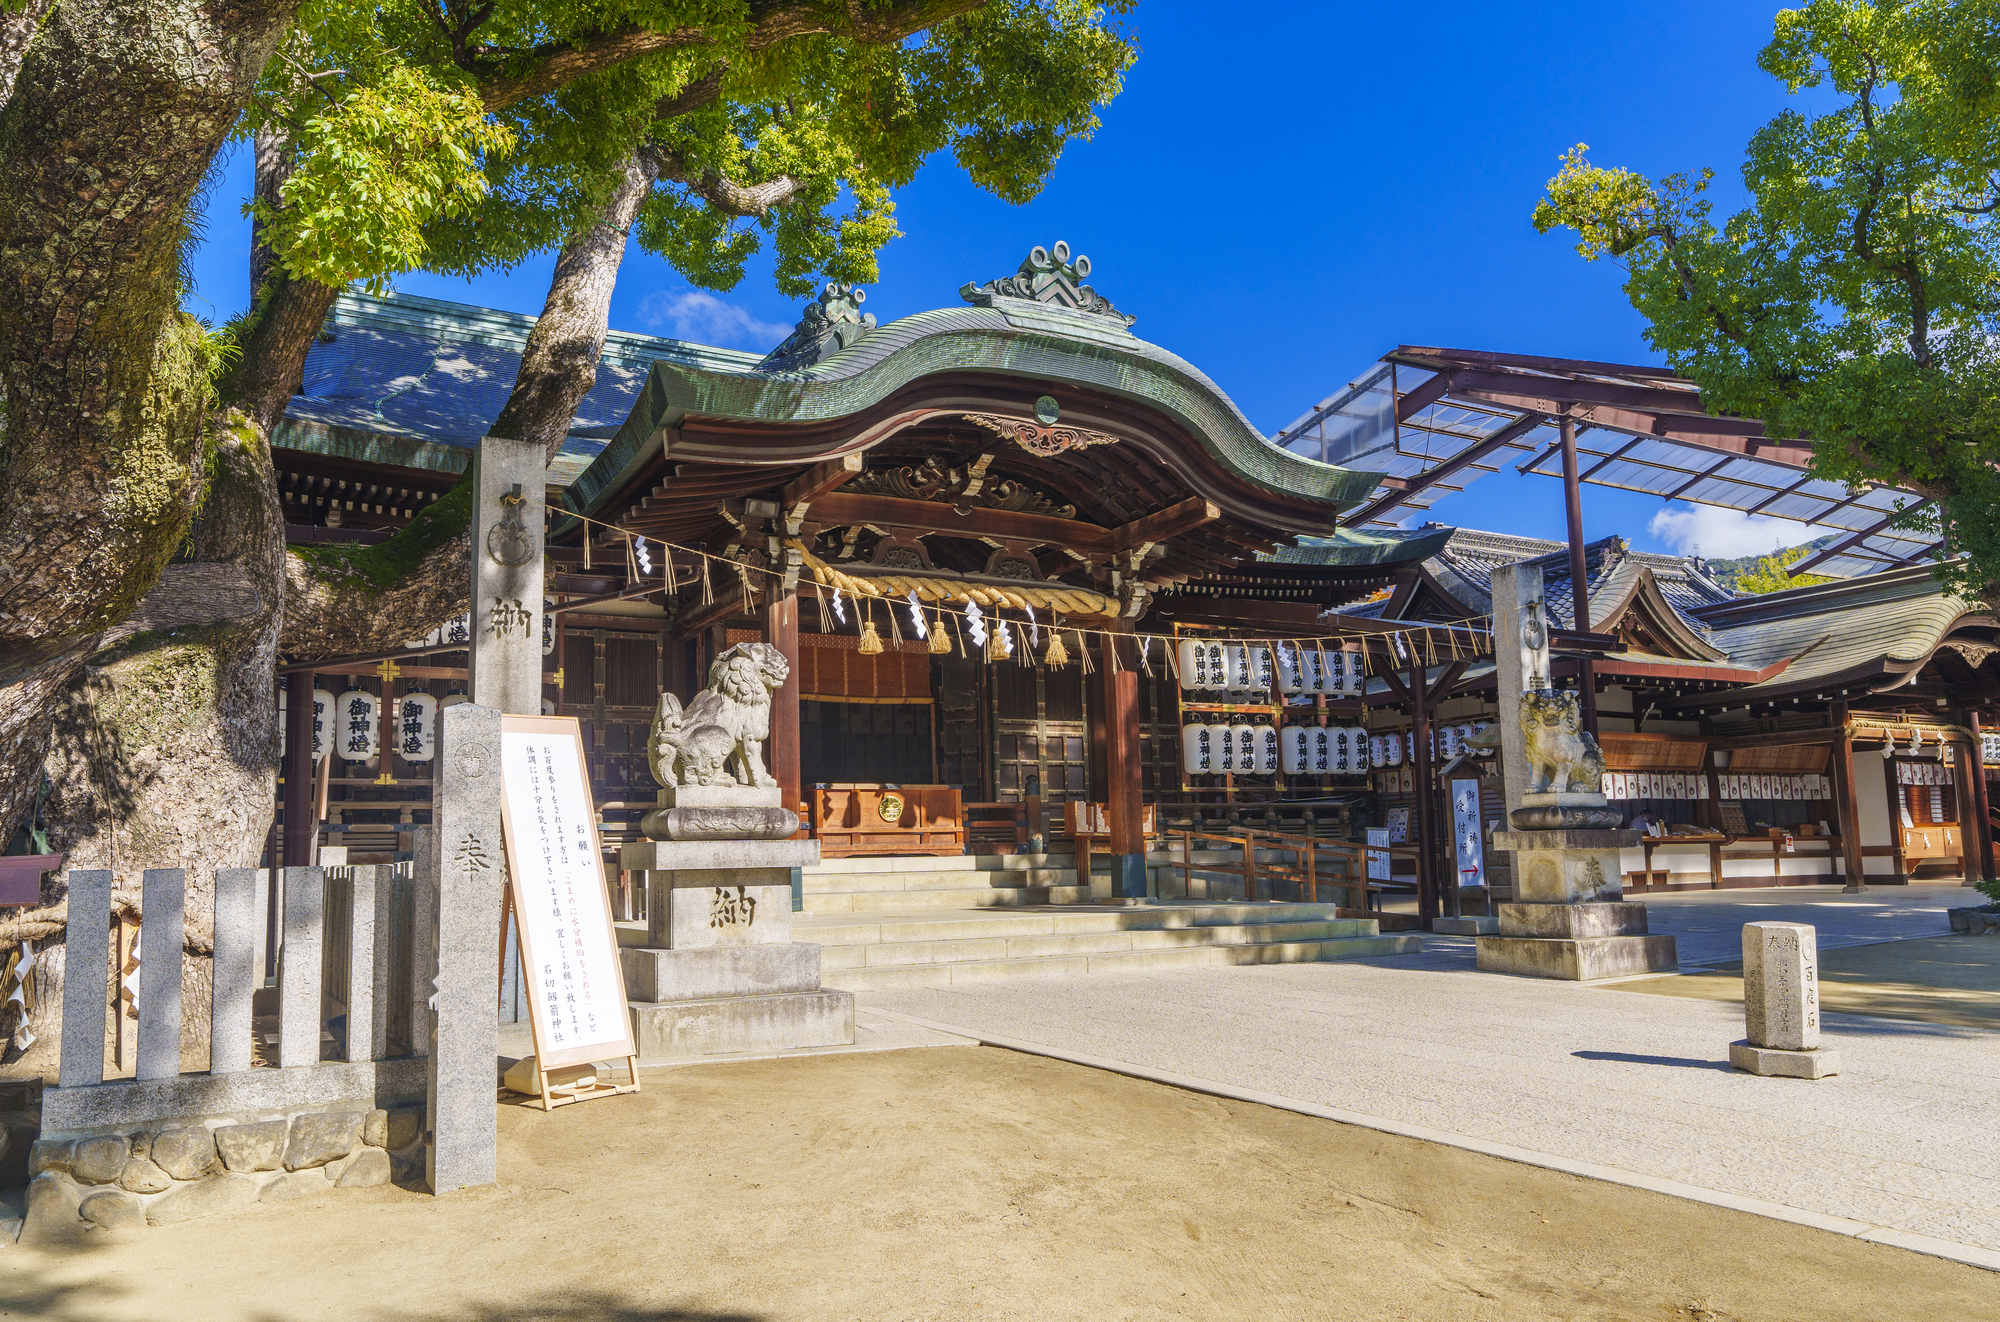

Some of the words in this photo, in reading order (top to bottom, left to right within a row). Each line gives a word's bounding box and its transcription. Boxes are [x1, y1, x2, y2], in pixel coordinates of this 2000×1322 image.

[485, 597, 532, 639] 納
[348, 698, 371, 754] 御神燈
[402, 700, 424, 754] 御神燈
[577, 824, 591, 866] お願い
[1456, 799, 1467, 855] 受付所
[454, 833, 491, 882] 奉
[1584, 855, 1607, 894] 奉
[710, 885, 757, 928] 納
[1767, 935, 1799, 951] 奉納
